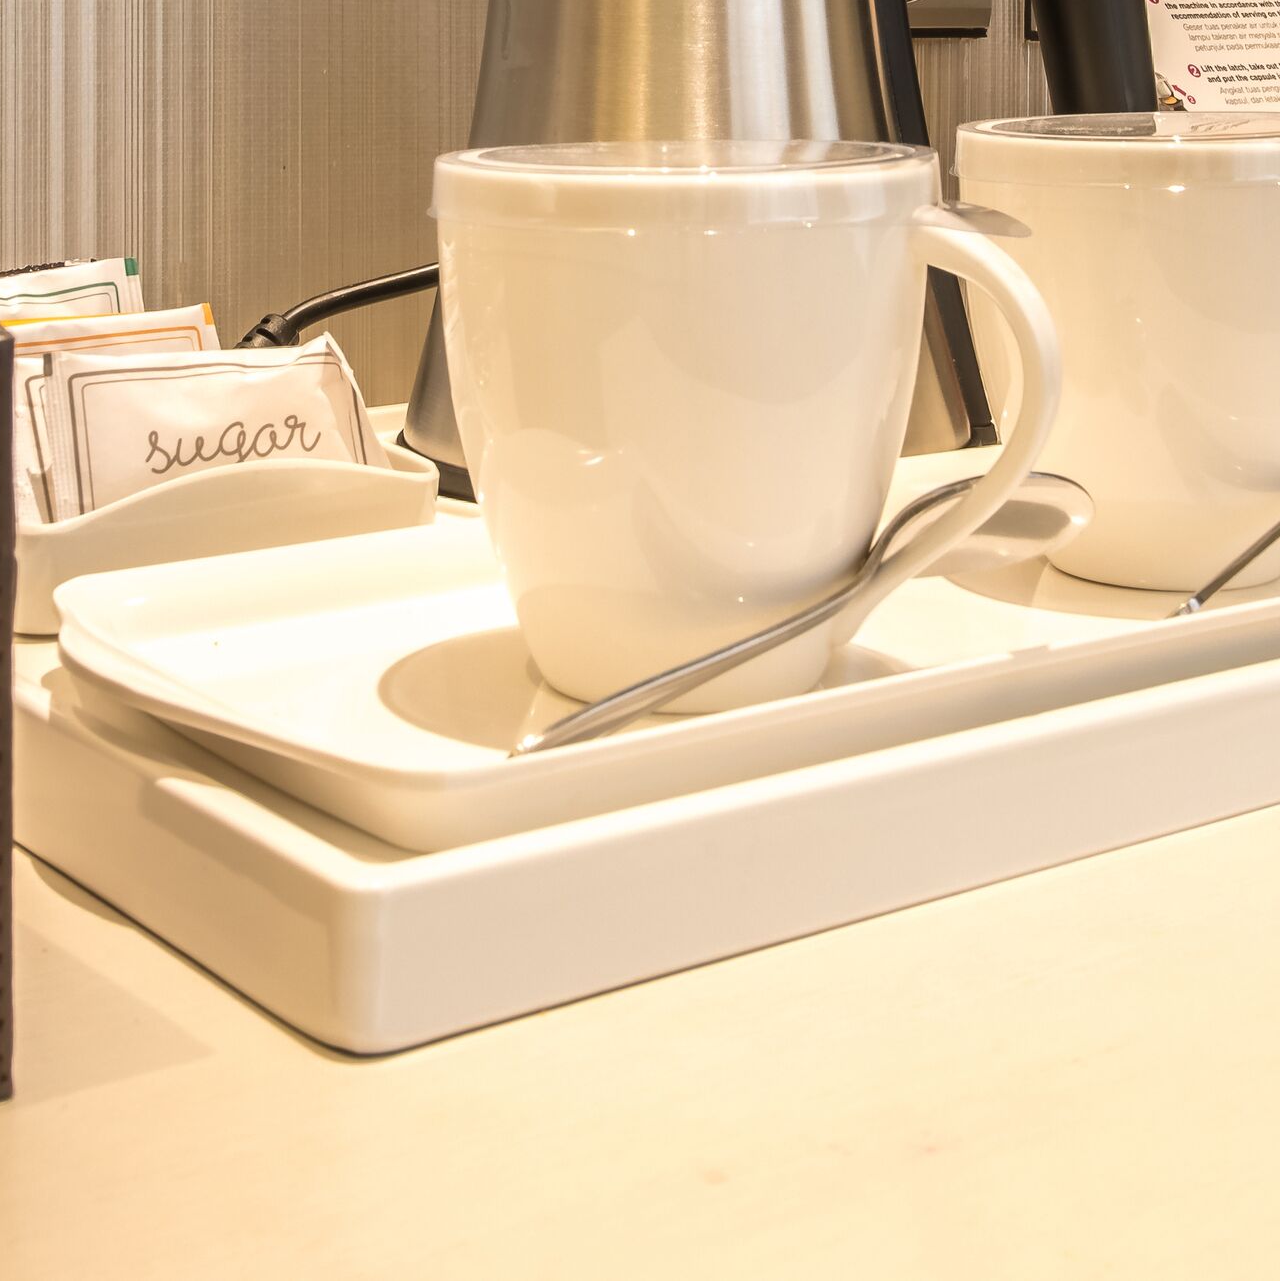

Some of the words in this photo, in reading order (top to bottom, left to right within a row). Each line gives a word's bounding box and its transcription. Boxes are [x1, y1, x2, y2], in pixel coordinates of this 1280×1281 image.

[1165, 2, 1178, 10] the
[1179, 1, 1209, 9] machine
[1259, 0, 1275, 8] with
[1170, 12, 1232, 20] recommendation
[1241, 10, 1268, 19] serving
[1201, 64, 1216, 73] Lift
[1215, 64, 1228, 72] the
[1227, 63, 1250, 72] latch,
[1249, 62, 1266, 71] take
[1266, 62, 1279, 70] out
[1207, 75, 1222, 83] and
[1222, 75, 1236, 84] put
[1235, 74, 1249, 82] the
[1249, 72, 1276, 81] capsule
[145, 413, 322, 476] sugar
